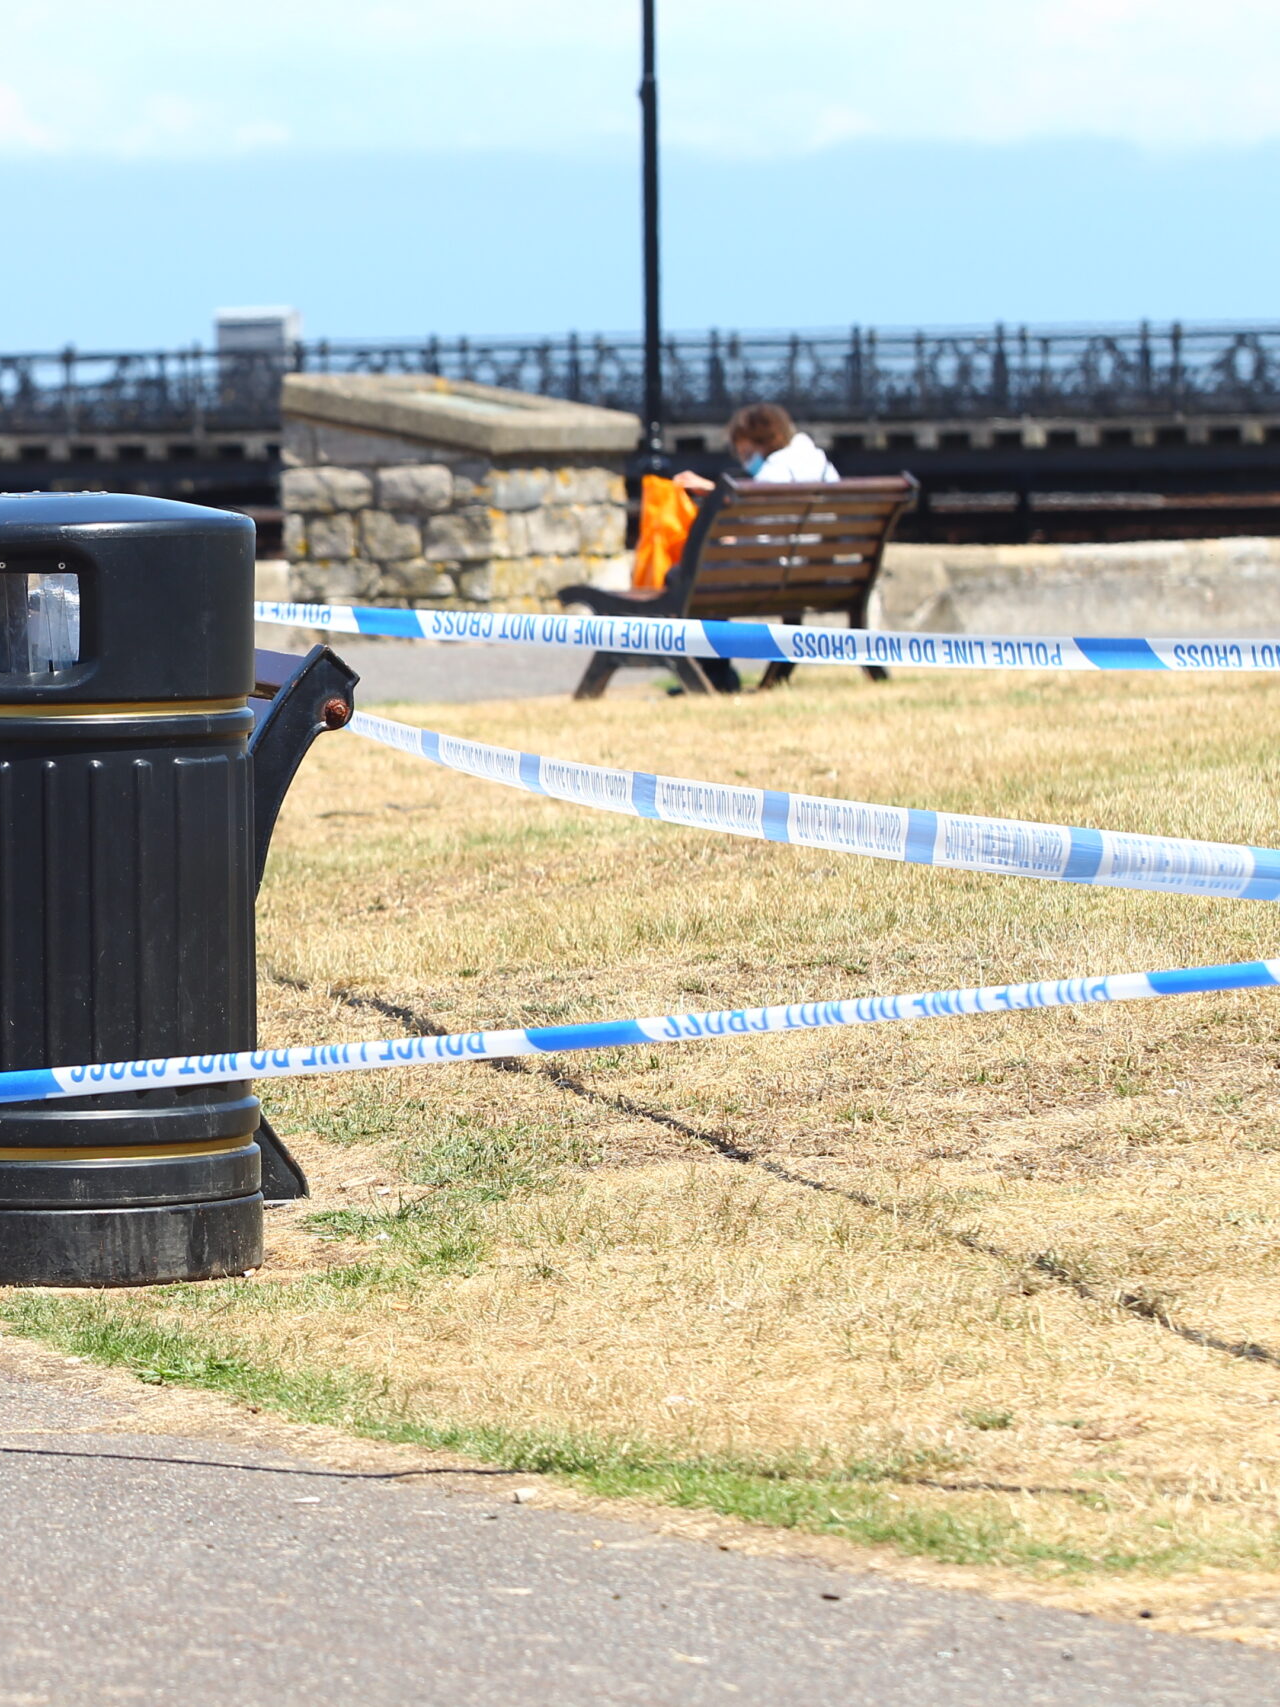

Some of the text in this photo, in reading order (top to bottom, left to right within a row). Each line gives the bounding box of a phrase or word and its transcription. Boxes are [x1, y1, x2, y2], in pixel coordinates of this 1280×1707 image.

[432, 610, 686, 652] POLICE LINE DO NOT CROSS
[791, 632, 1063, 666] POLICE LINE DO NOT CROSS
[1174, 643, 1242, 669] CROSS
